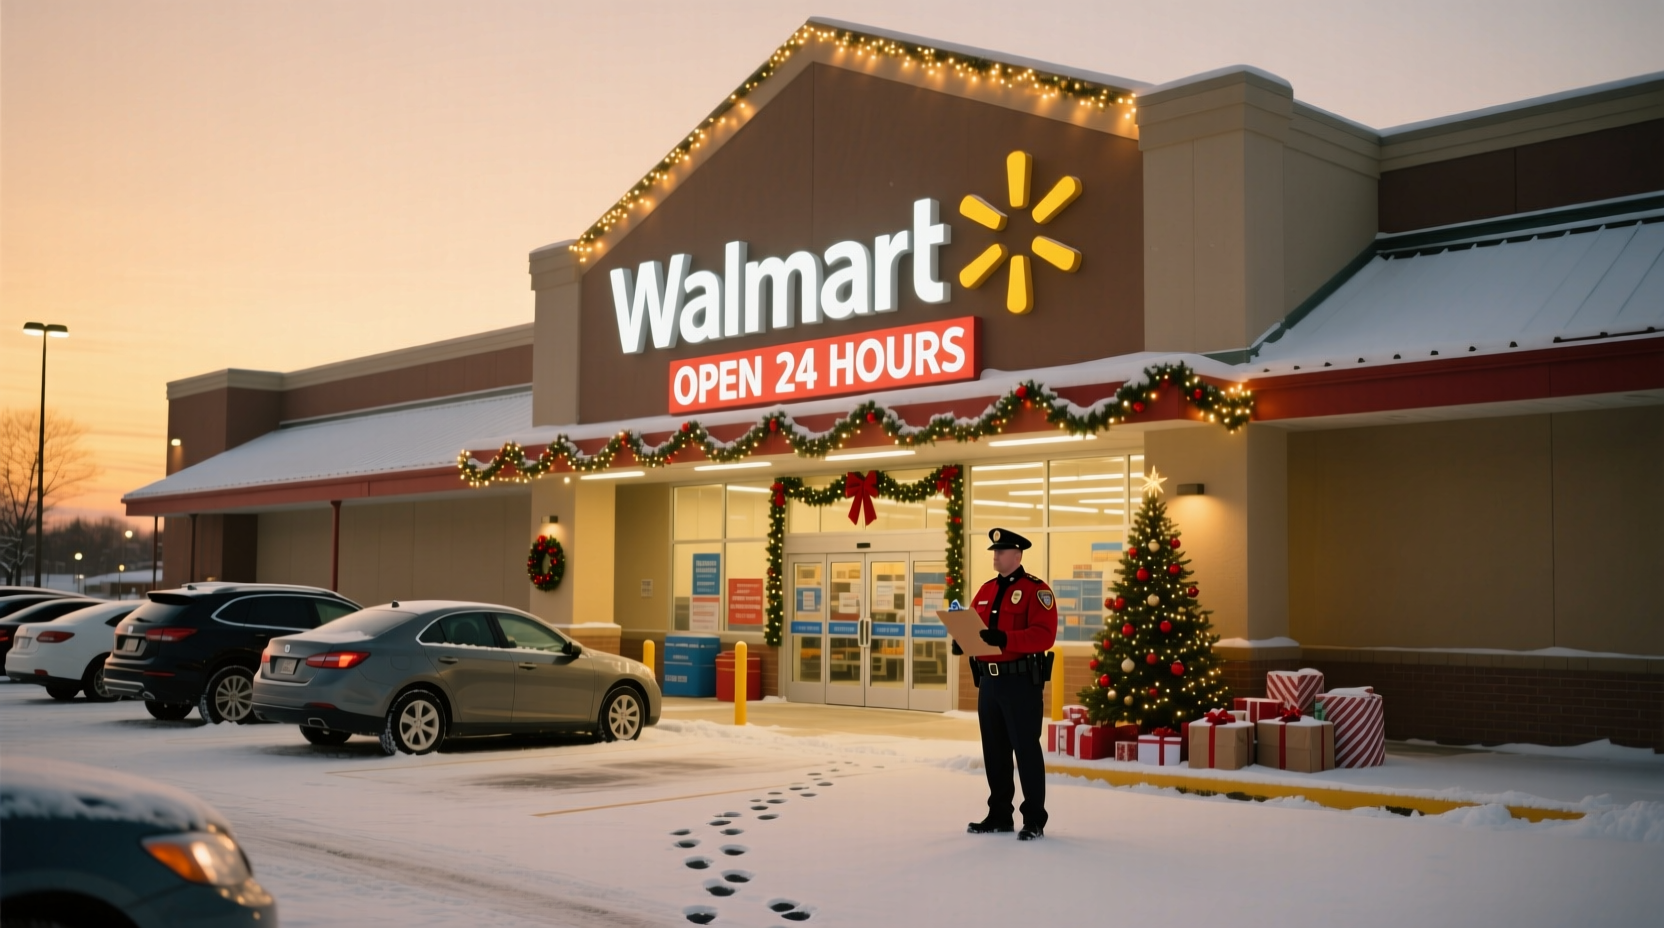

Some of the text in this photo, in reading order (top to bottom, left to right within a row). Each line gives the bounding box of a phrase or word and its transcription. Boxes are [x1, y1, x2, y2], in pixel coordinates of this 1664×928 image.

[610, 198, 951, 354] Walmart
[673, 326, 966, 406] OPEN 24 HOURS
